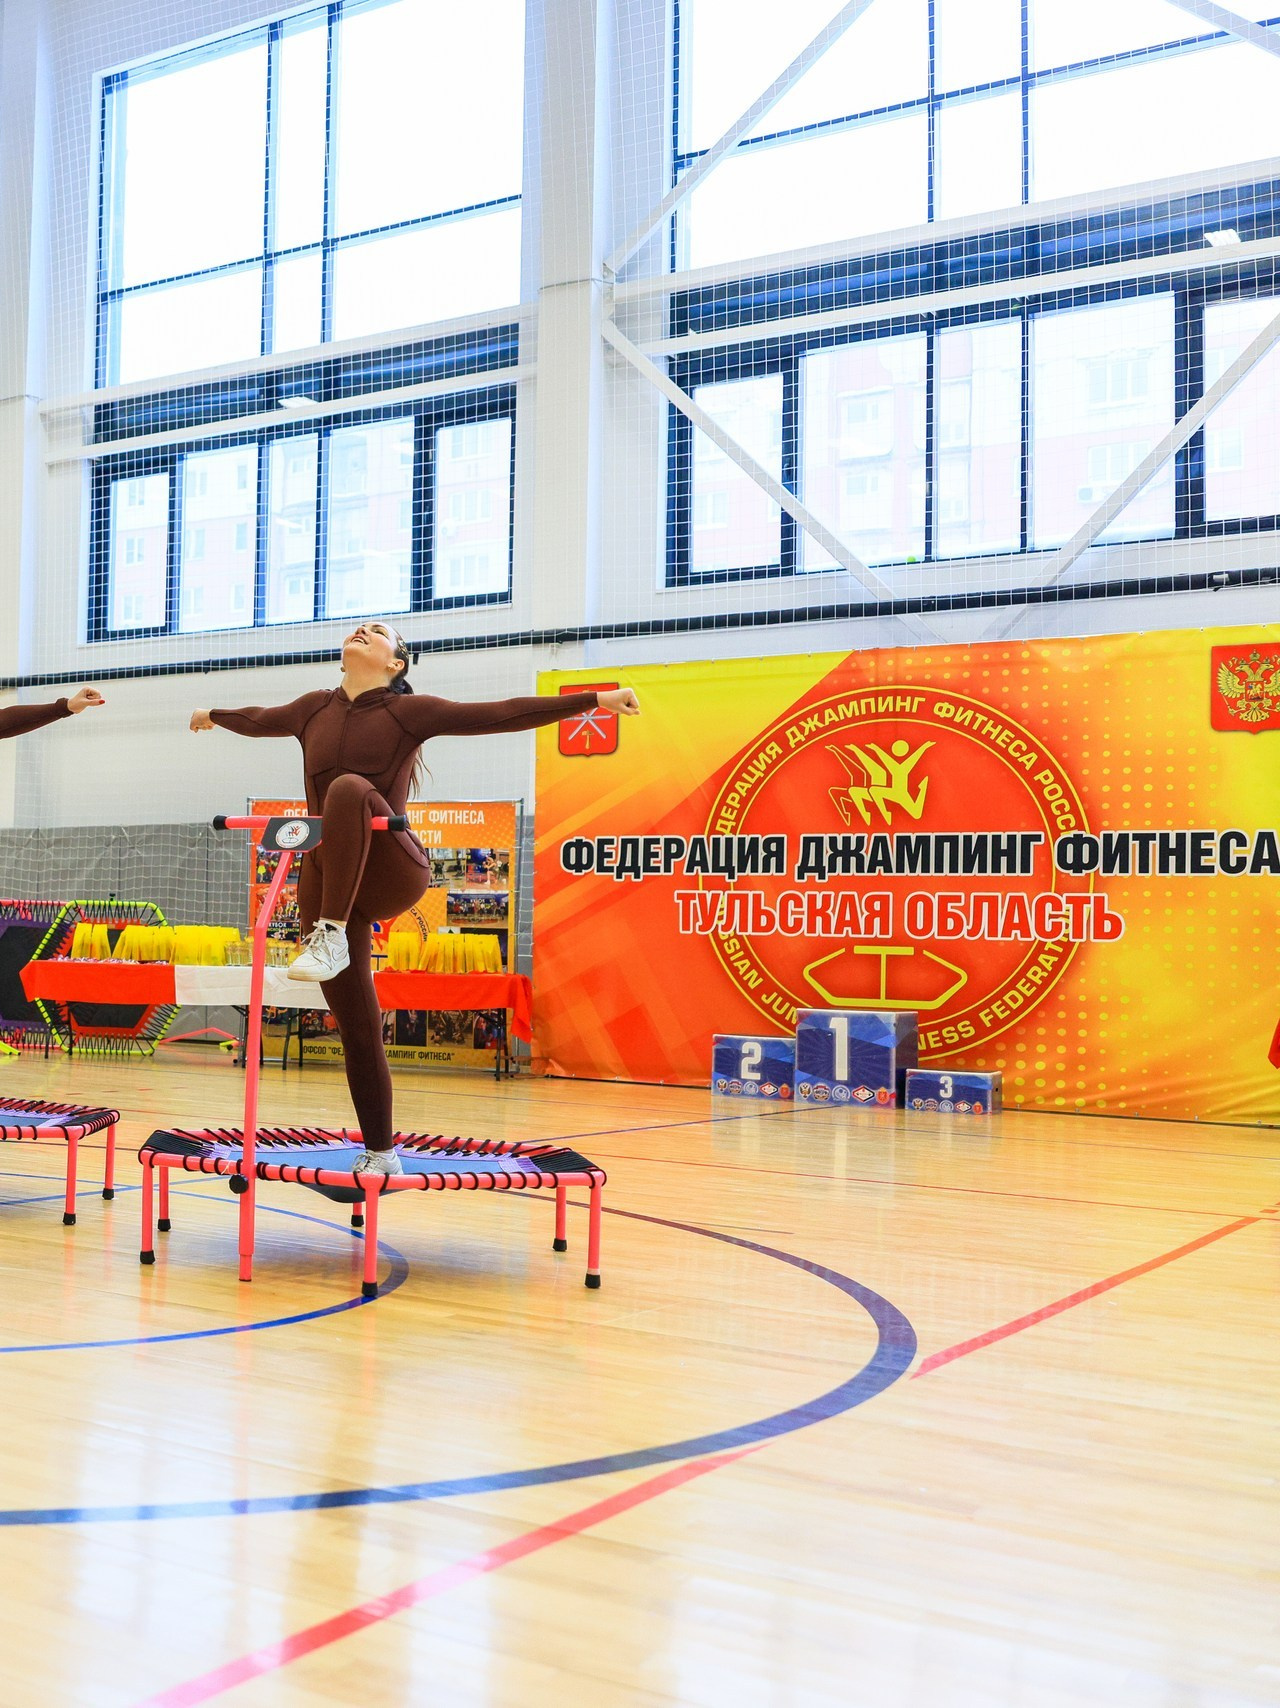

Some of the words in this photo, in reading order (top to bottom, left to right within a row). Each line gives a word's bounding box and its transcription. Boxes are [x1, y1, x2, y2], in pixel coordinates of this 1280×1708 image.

[715, 741, 783, 835] ДЕРАЦИЯ
[784, 696, 926, 748] ДЖАМПИНГ
[933, 701, 1037, 771] ФИТНЕСА
[1033, 768, 1077, 836] РОСС
[428, 810, 485, 825] ФИТНЕСА
[561, 835, 787, 882] ФЕДЕРАЦИЯ
[795, 831, 1045, 882] ДЖАМПИНГ
[1055, 829, 1280, 876] ФИТНЕСА
[674, 890, 894, 938] ТУЛЬСКАЯ
[904, 892, 1126, 942] ОБЛАСТЬ
[740, 1042, 762, 1080] 2
[829, 1017, 849, 1081] 1
[939, 1076, 953, 1098] 3
